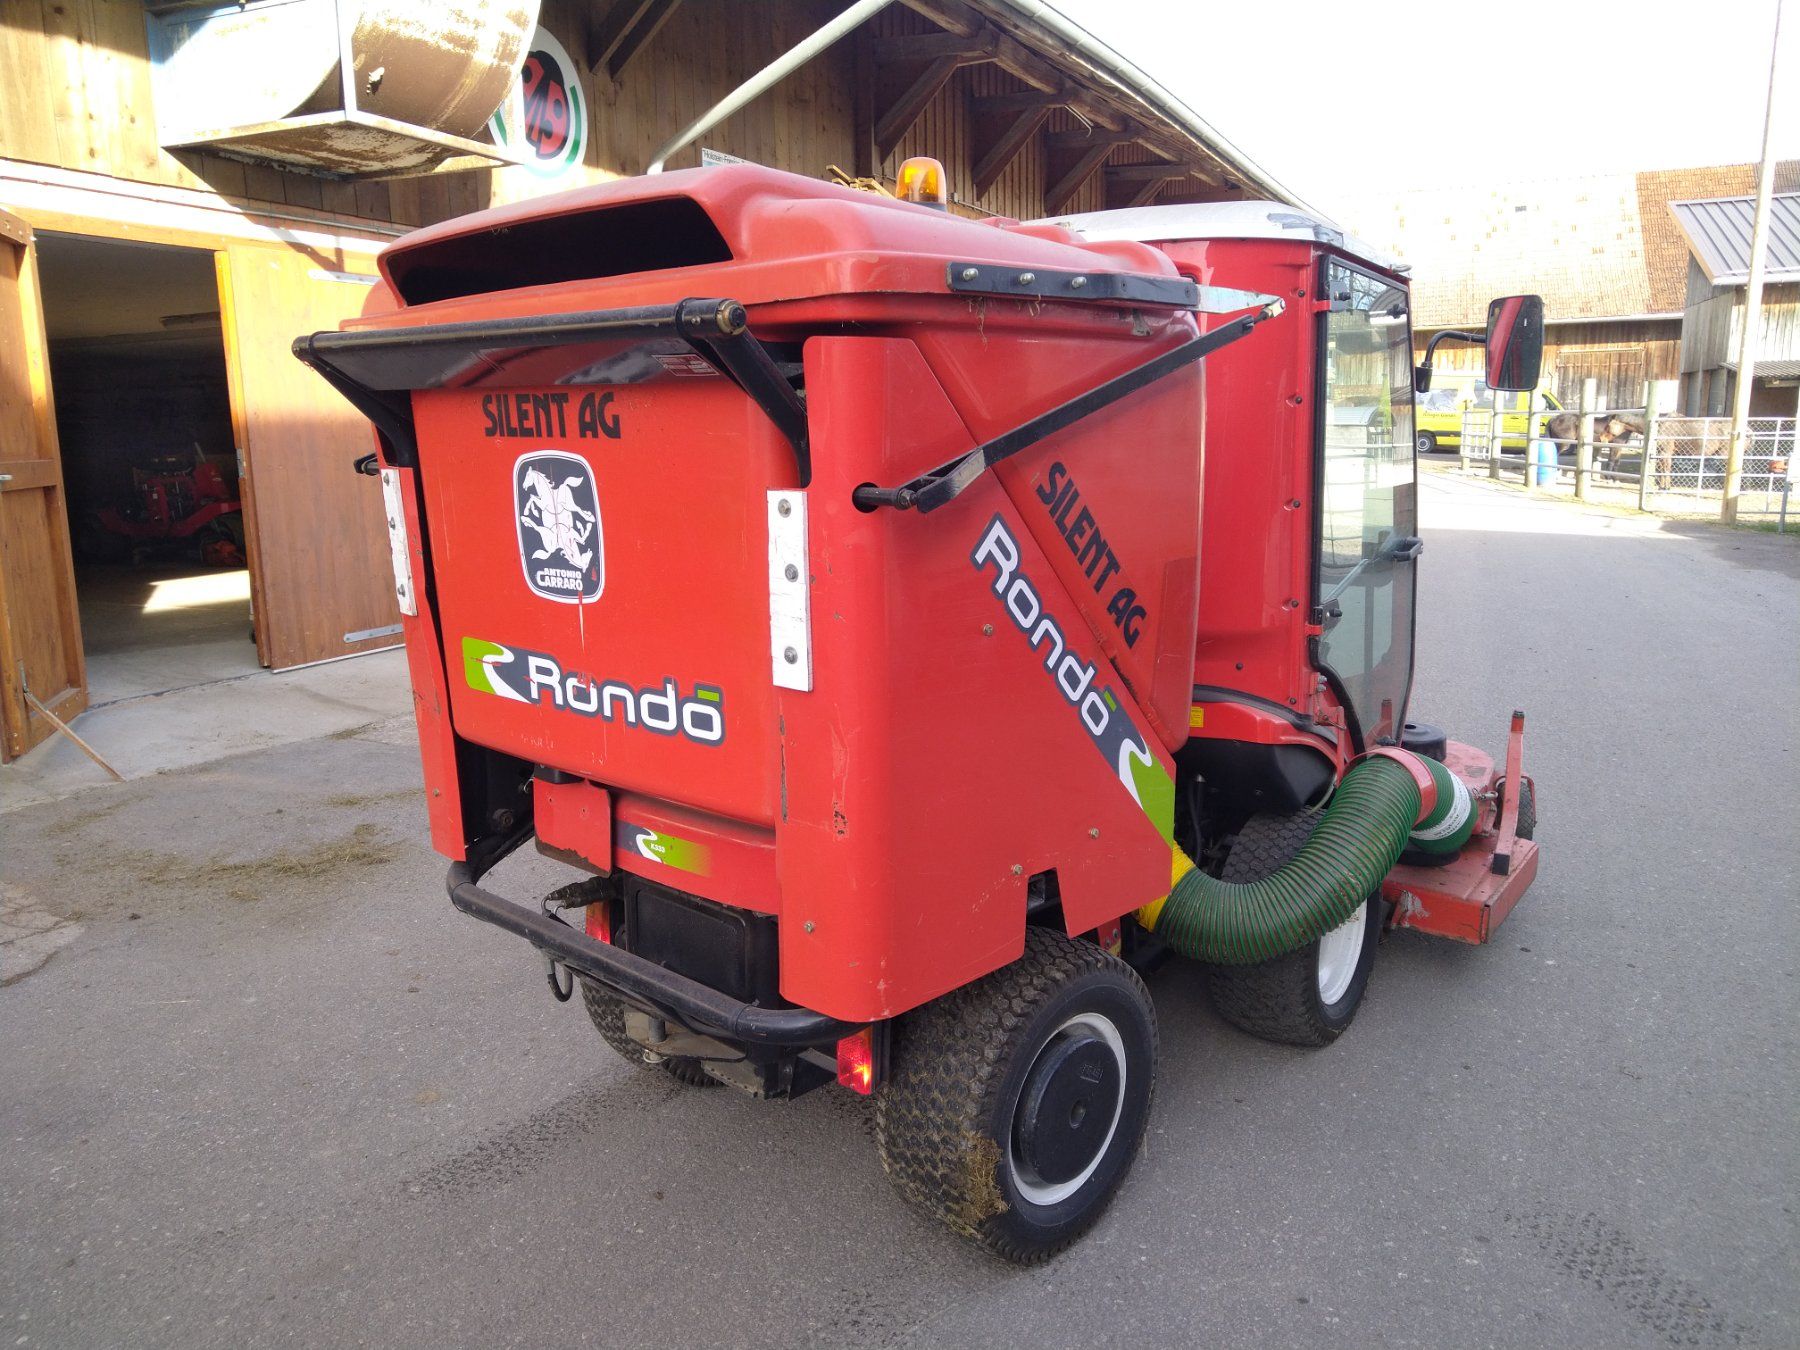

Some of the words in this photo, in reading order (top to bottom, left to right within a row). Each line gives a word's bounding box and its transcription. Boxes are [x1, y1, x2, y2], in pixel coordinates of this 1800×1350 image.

[482, 392, 569, 438] SILENT
[578, 391, 621, 439] AG
[1036, 461, 1120, 593] SILENT
[1106, 588, 1147, 649] AG
[536, 570, 583, 591] CARRARO
[543, 567, 582, 580] ANTONIO
